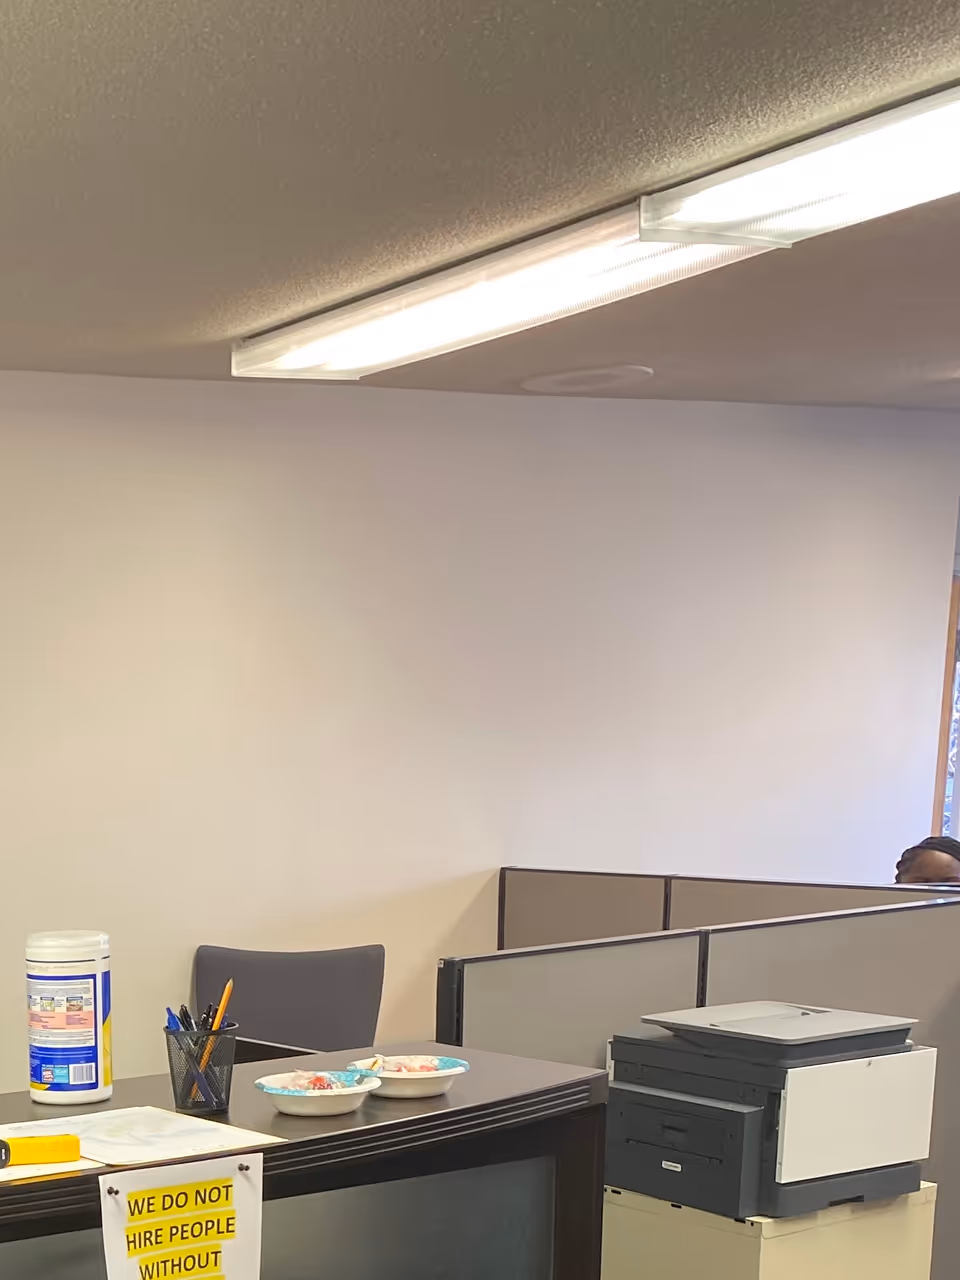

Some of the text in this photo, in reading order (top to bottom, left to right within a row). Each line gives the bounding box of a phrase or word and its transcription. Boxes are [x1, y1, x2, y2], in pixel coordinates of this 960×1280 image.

[127, 1184, 233, 1216] WE DO NOT
[126, 1217, 235, 1251] HIRE PEOPLE
